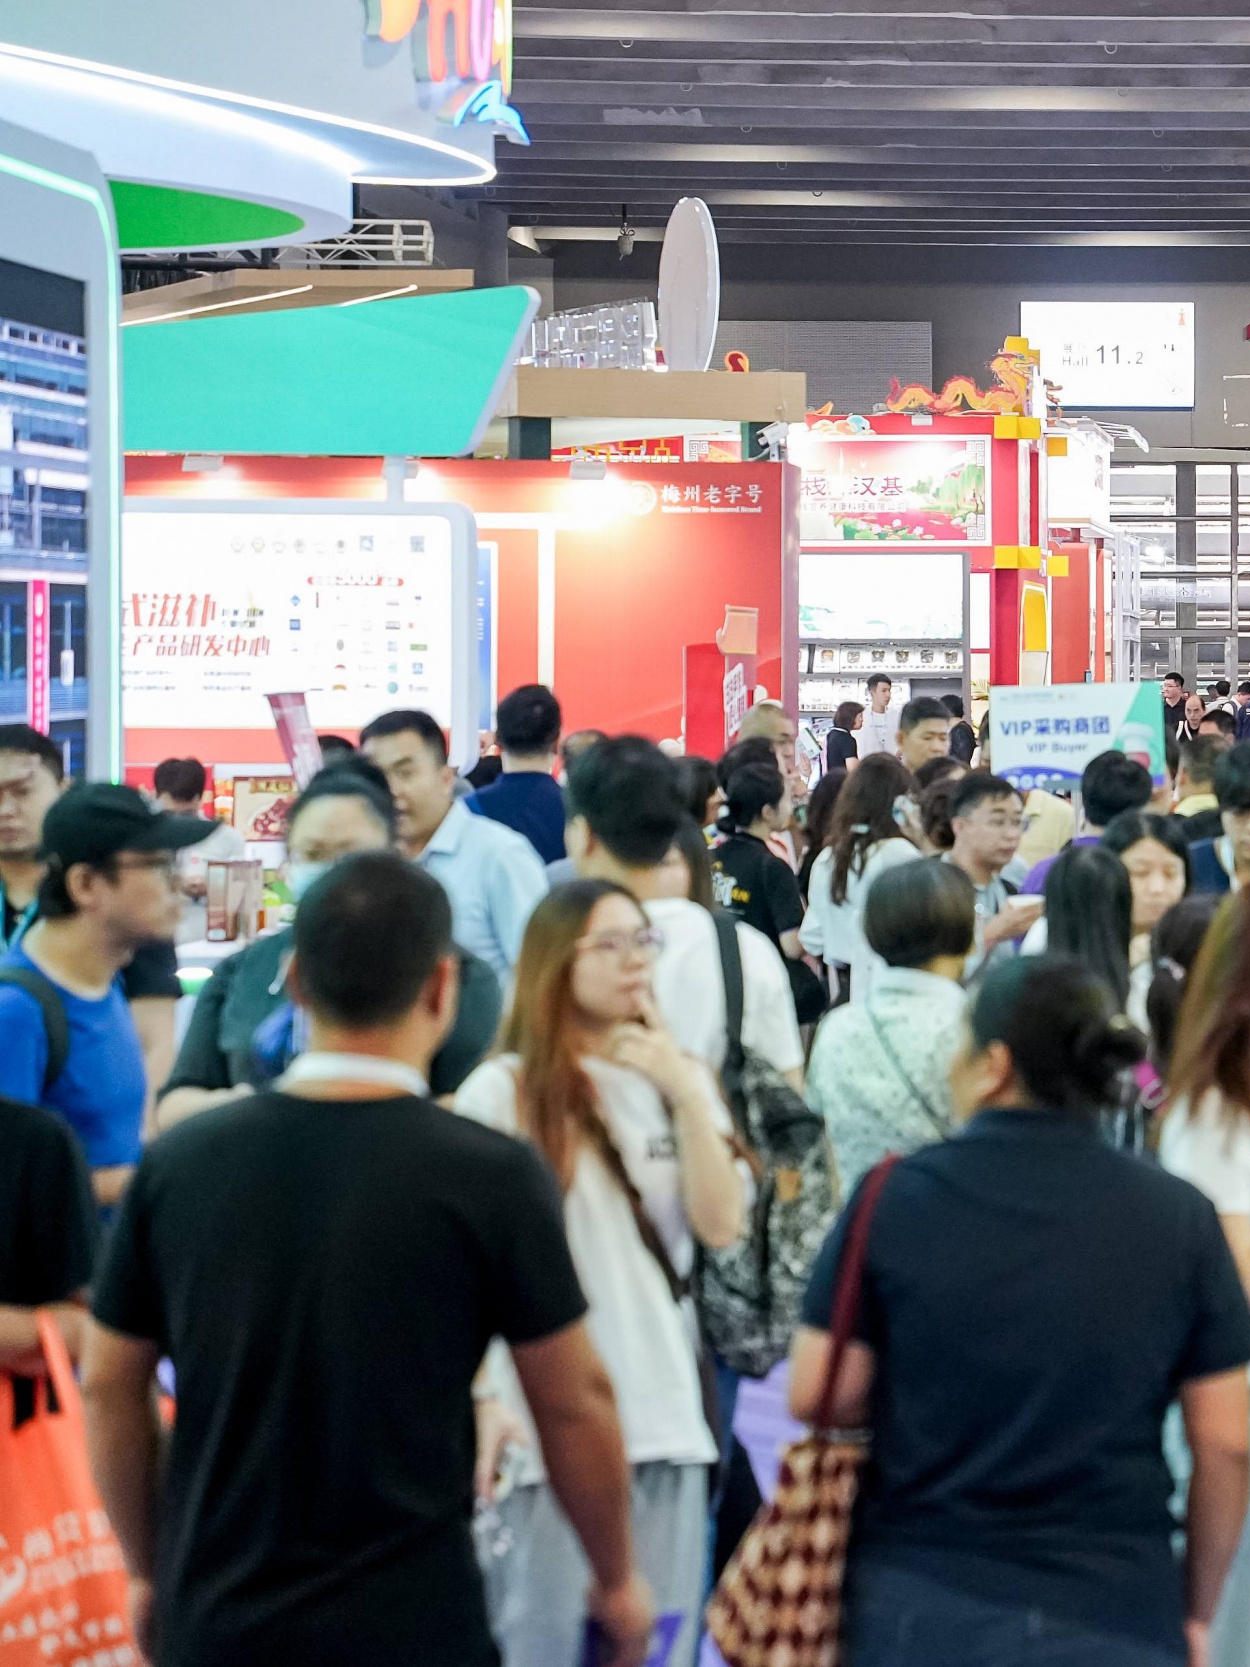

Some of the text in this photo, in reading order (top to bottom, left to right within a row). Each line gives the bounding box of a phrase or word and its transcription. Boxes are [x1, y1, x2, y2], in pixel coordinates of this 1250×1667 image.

[1062, 344, 1143, 366] Hall 11.2
[661, 484, 763, 503] 梅州老字号
[122, 634, 270, 656] 产品研发中心
[1000, 715, 1110, 737] VIP采购商团
[1027, 743, 1088, 753] VIP Buyer
